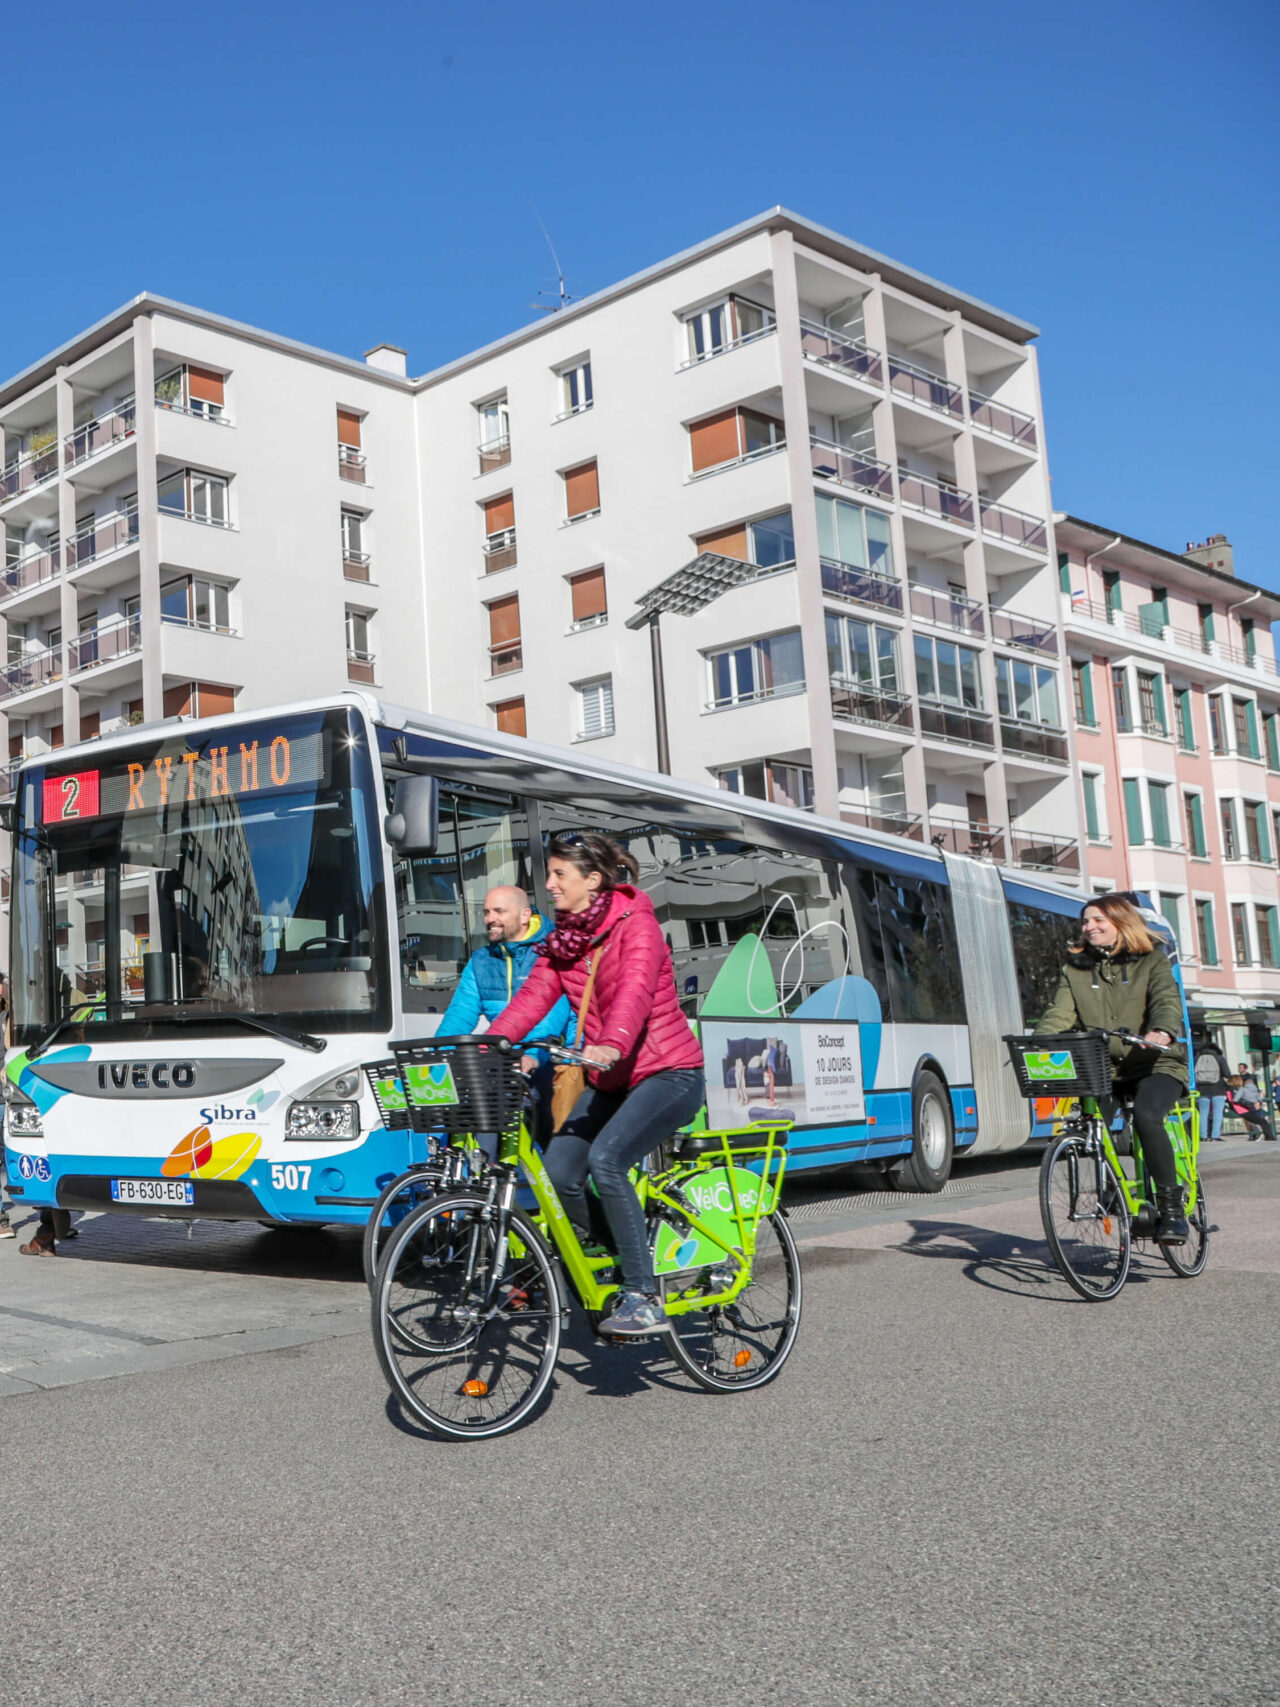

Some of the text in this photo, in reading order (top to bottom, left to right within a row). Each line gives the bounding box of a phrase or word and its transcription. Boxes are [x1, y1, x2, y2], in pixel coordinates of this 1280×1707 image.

[127, 735, 291, 811] RYTHMO
[61, 777, 80, 819] 2
[98, 1062, 197, 1089] IVECO
[816, 1057, 852, 1073] 10 JOURS
[200, 1103, 256, 1125] Sibra
[119, 1182, 183, 1200] FB-630-EG
[271, 1165, 312, 1191] 507
